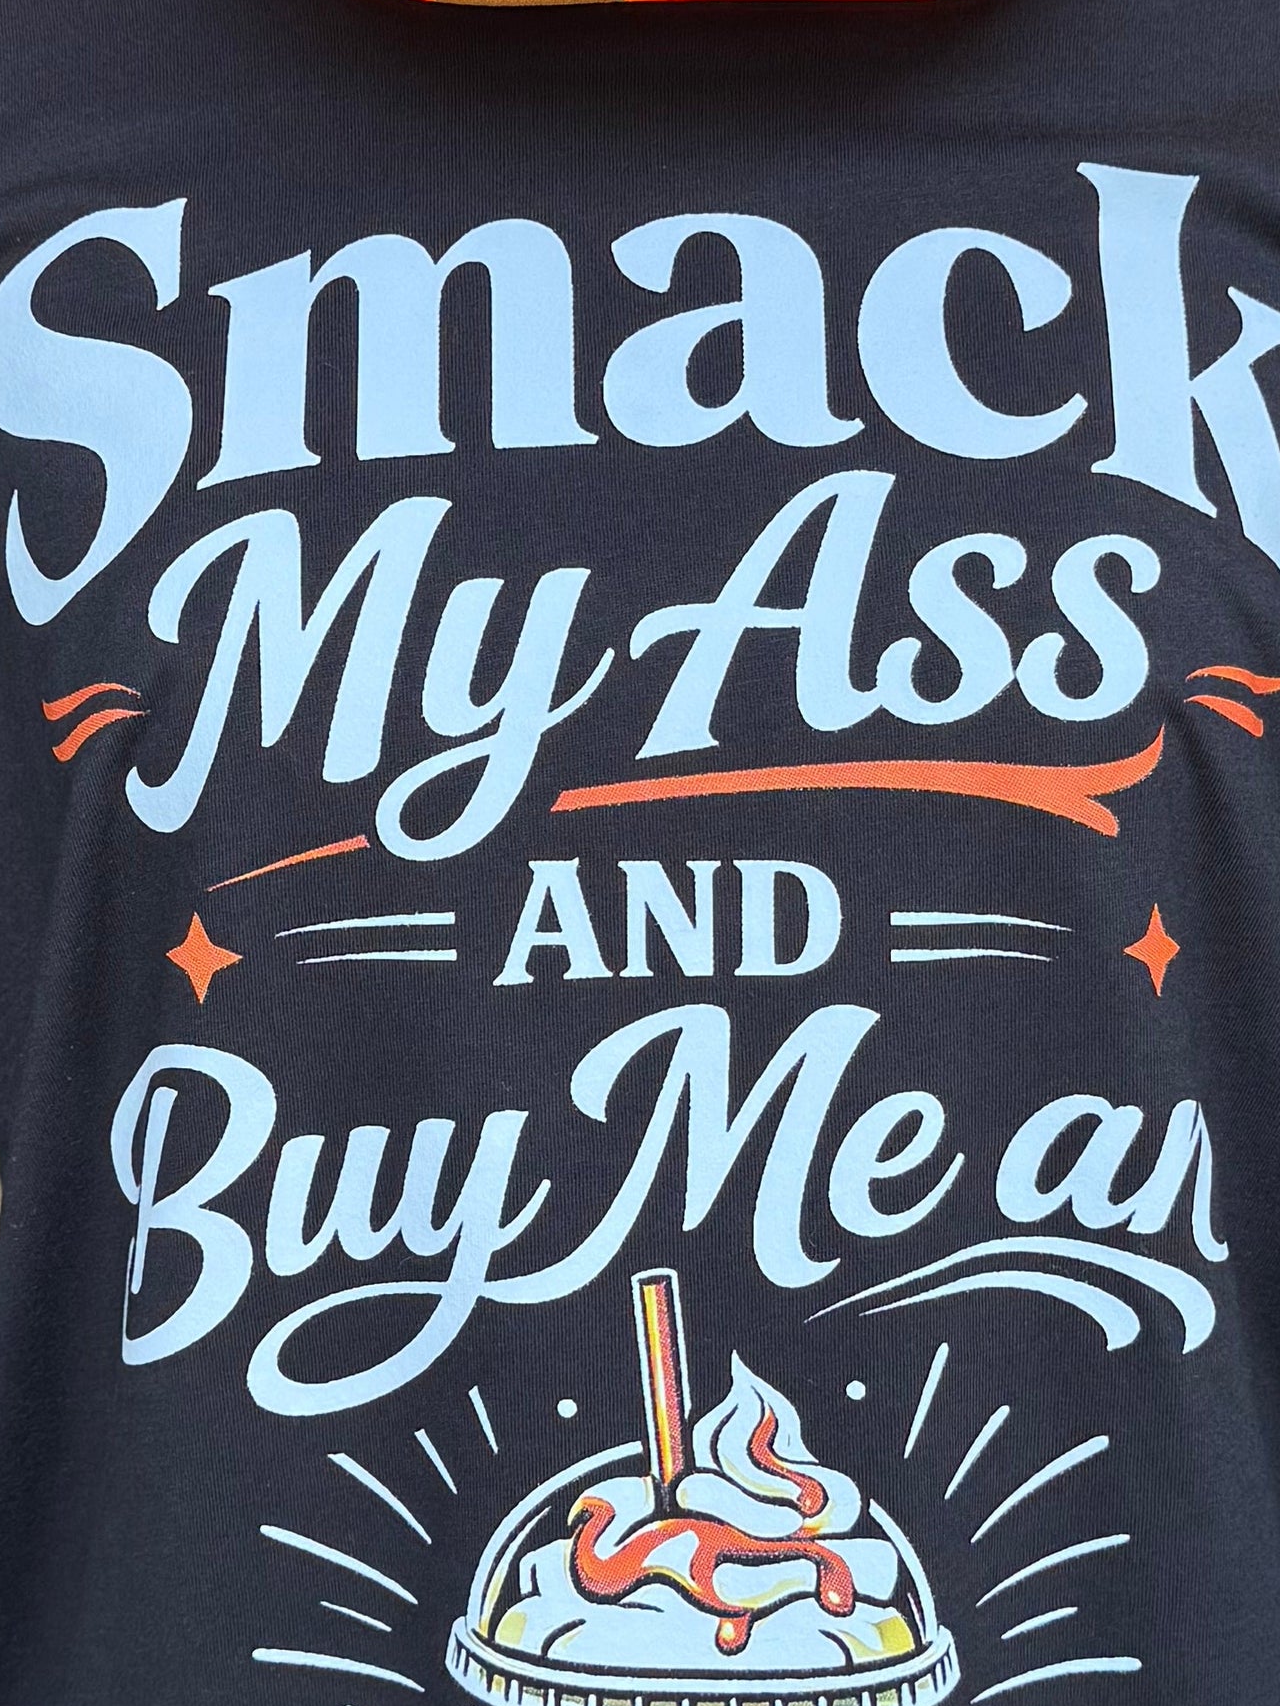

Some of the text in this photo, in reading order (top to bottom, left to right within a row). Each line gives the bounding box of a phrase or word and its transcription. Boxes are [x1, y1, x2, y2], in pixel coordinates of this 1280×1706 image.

[125, 470, 1161, 860] My Ass
[494, 859, 844, 985] AND
[111, 1003, 1228, 1417] Buy Me an
